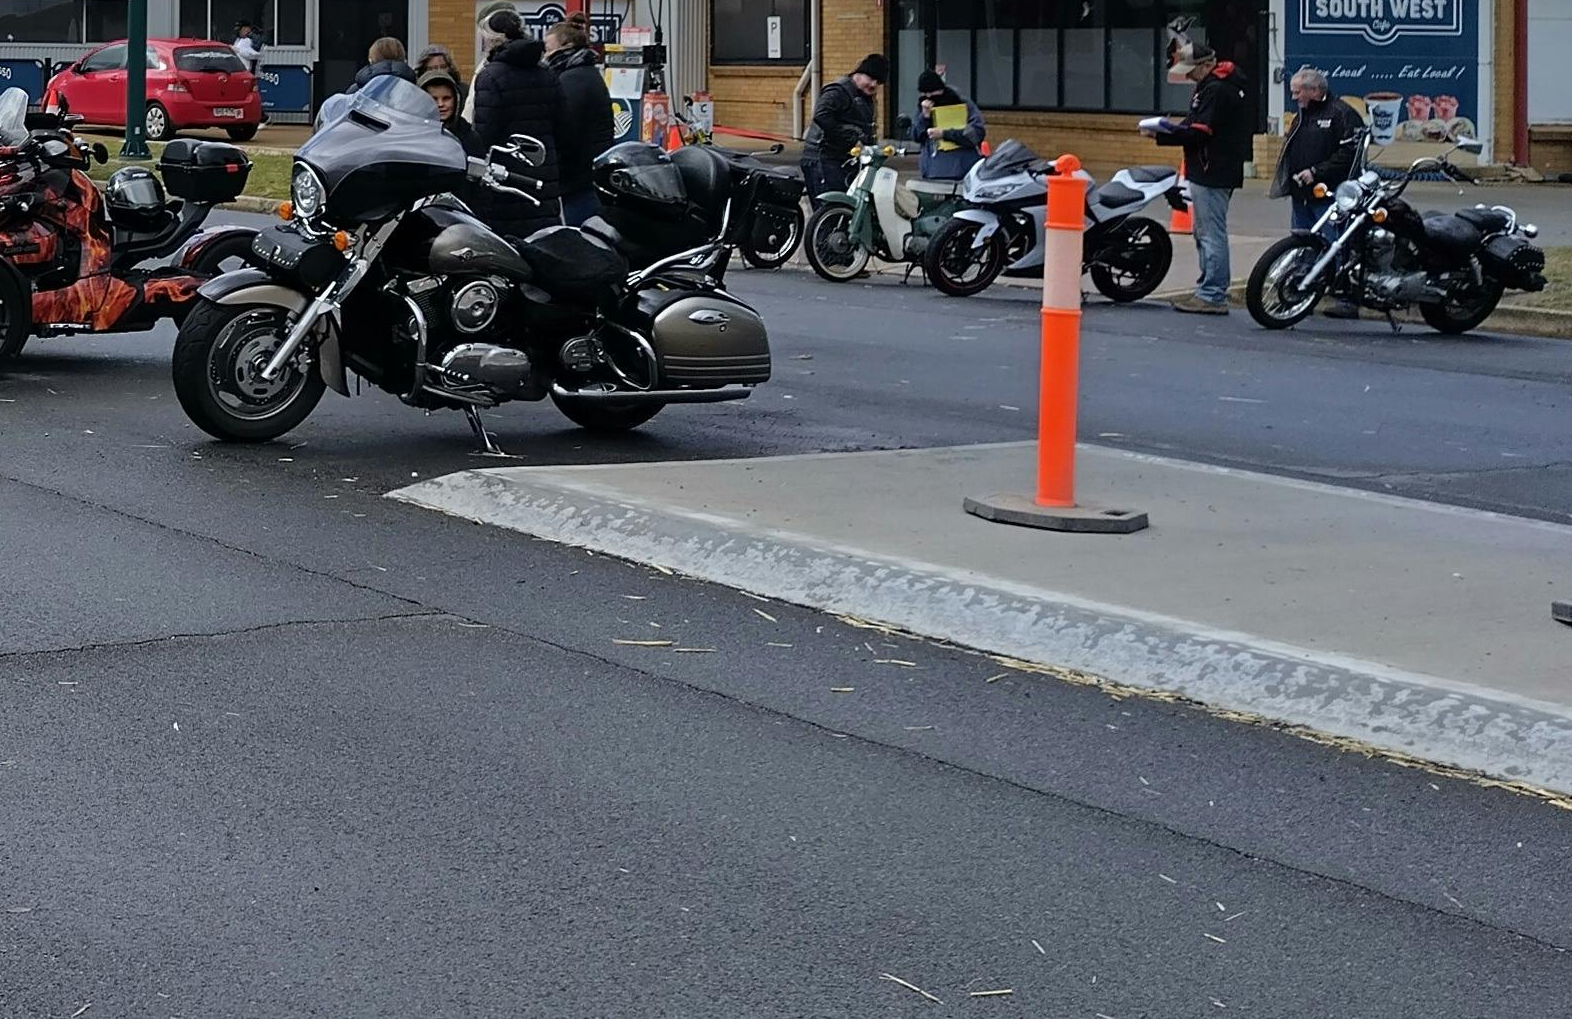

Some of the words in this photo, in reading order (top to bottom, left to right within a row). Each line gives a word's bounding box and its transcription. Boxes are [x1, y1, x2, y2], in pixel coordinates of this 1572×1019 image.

[771, 22, 777, 35] P
[1331, 64, 1367, 78] Local
[1398, 64, 1421, 79] Eat
[1422, 65, 1455, 79] Local
